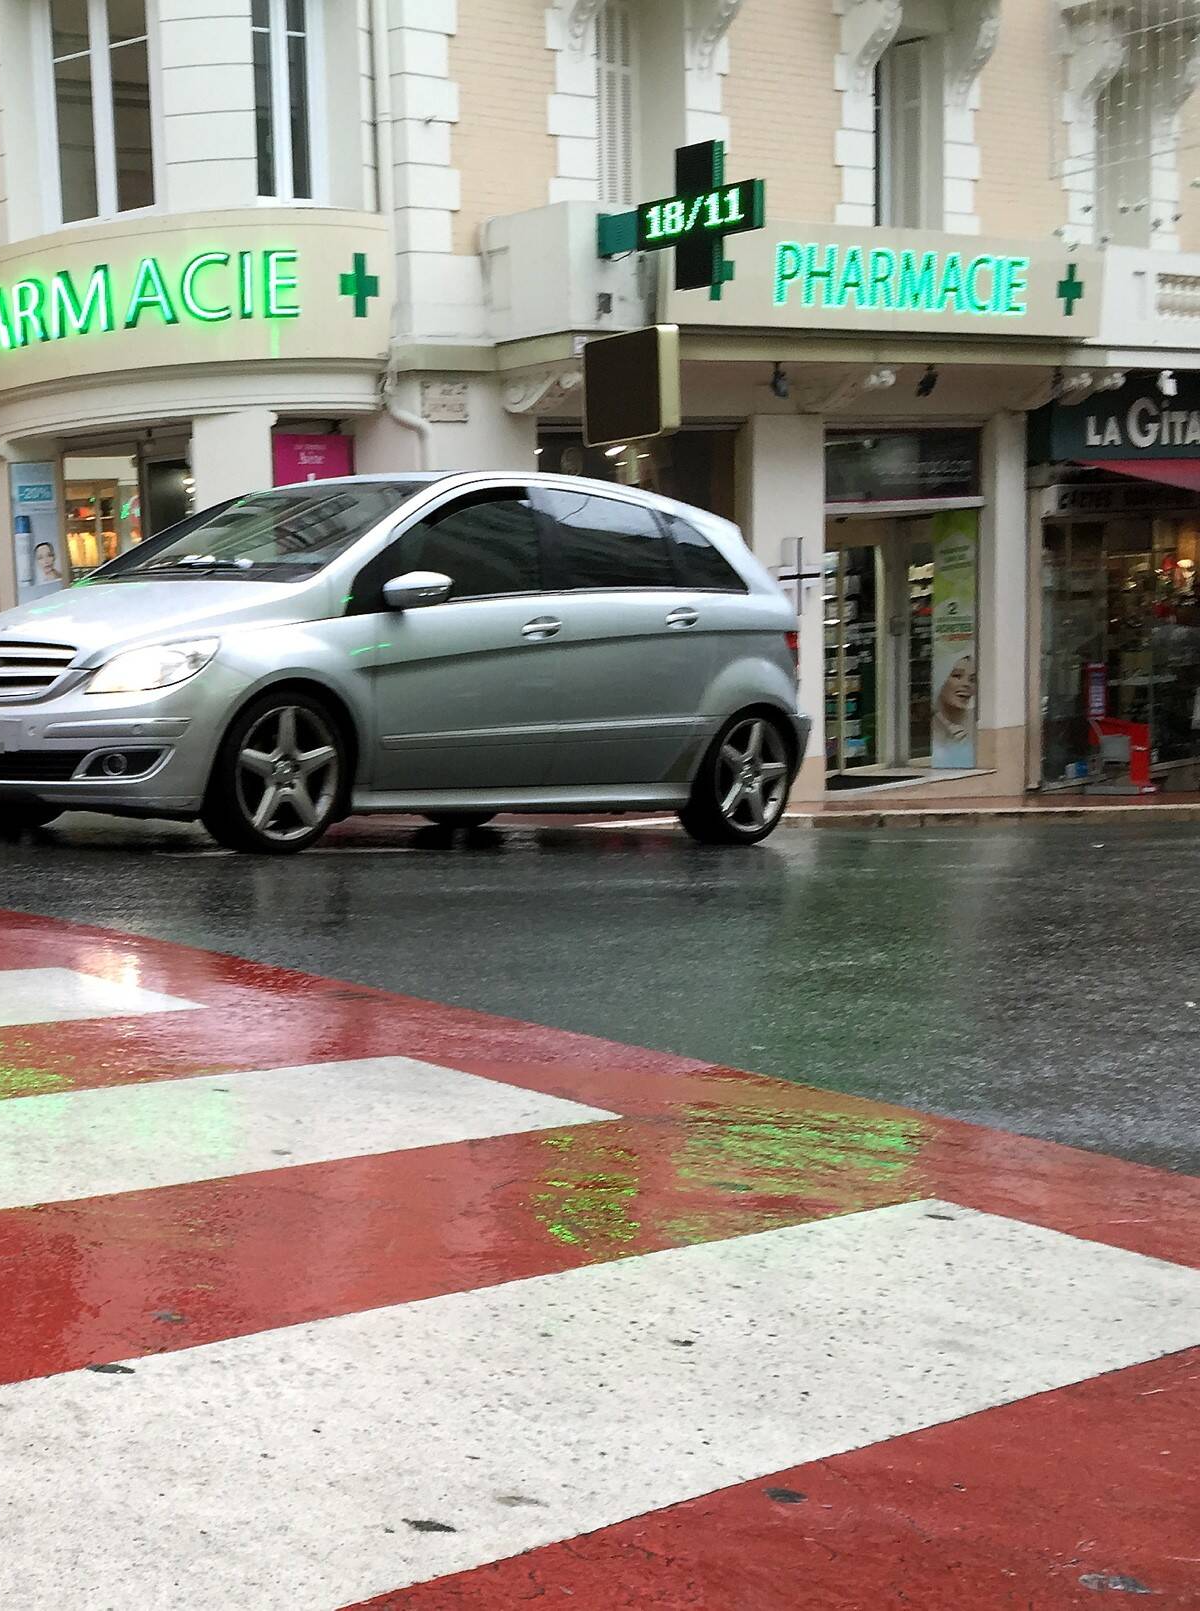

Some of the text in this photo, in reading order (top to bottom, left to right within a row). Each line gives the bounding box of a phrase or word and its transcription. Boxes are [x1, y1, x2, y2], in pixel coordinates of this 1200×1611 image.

[646, 188, 745, 239] 18/11
[773, 240, 1030, 317] PHARMACIE
[1086, 415, 1121, 446] LA
